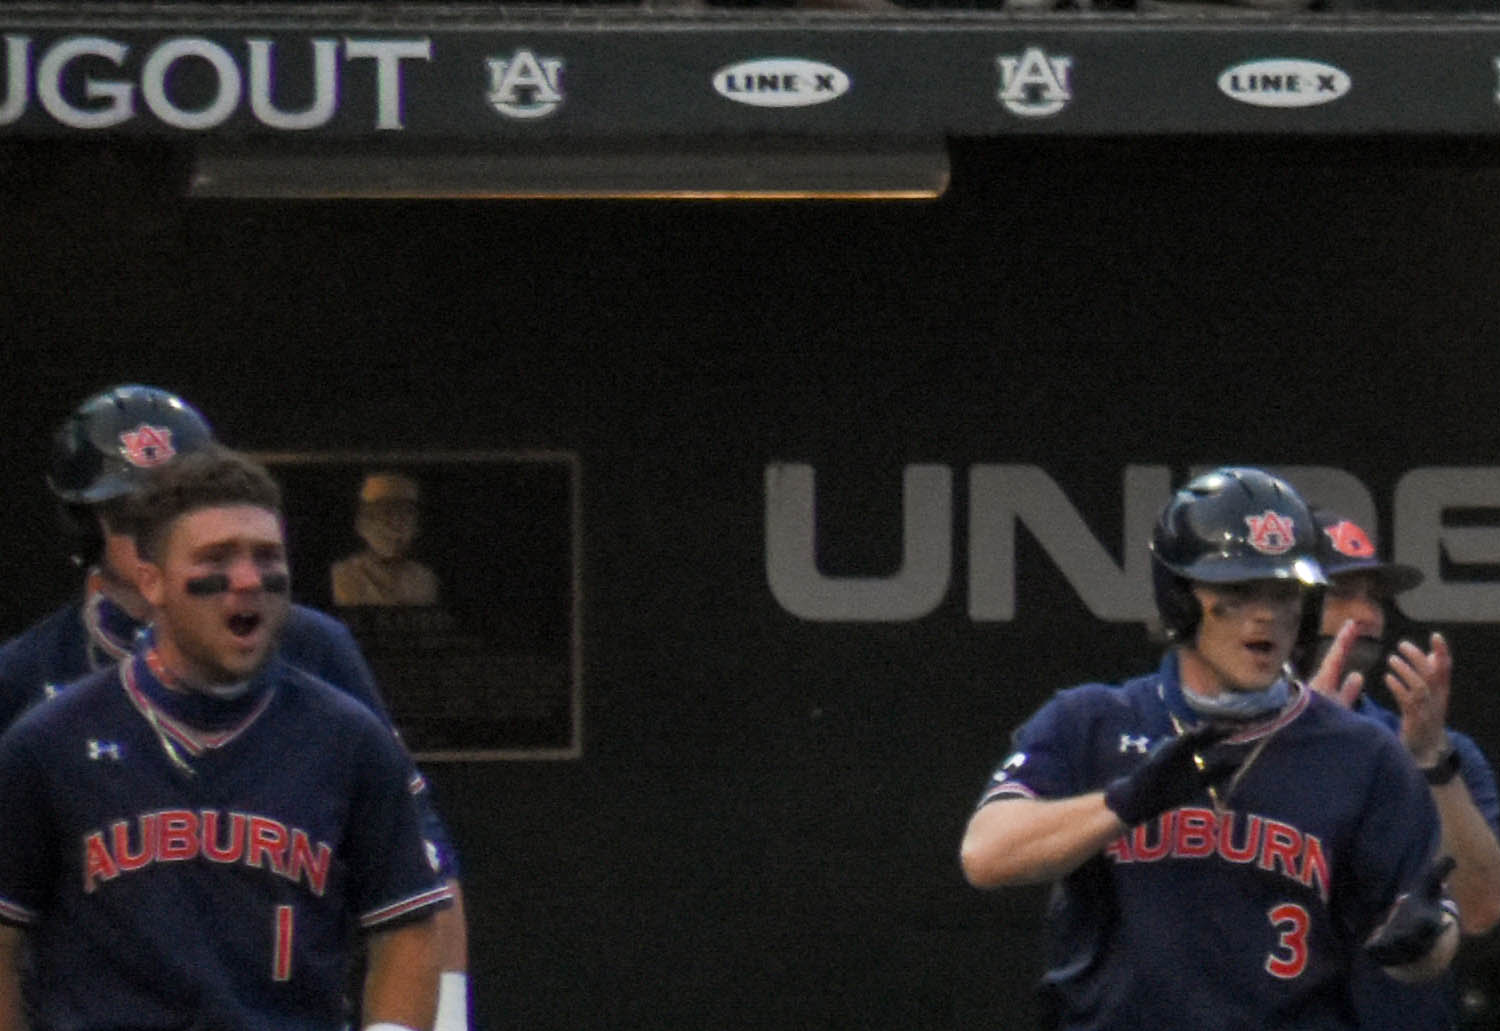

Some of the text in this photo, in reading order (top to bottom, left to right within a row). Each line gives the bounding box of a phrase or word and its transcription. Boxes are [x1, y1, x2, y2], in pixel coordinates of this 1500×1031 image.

[84, 810, 331, 896] AUBURN
[272, 905, 293, 982] 1
[1265, 903, 1310, 979] 3
